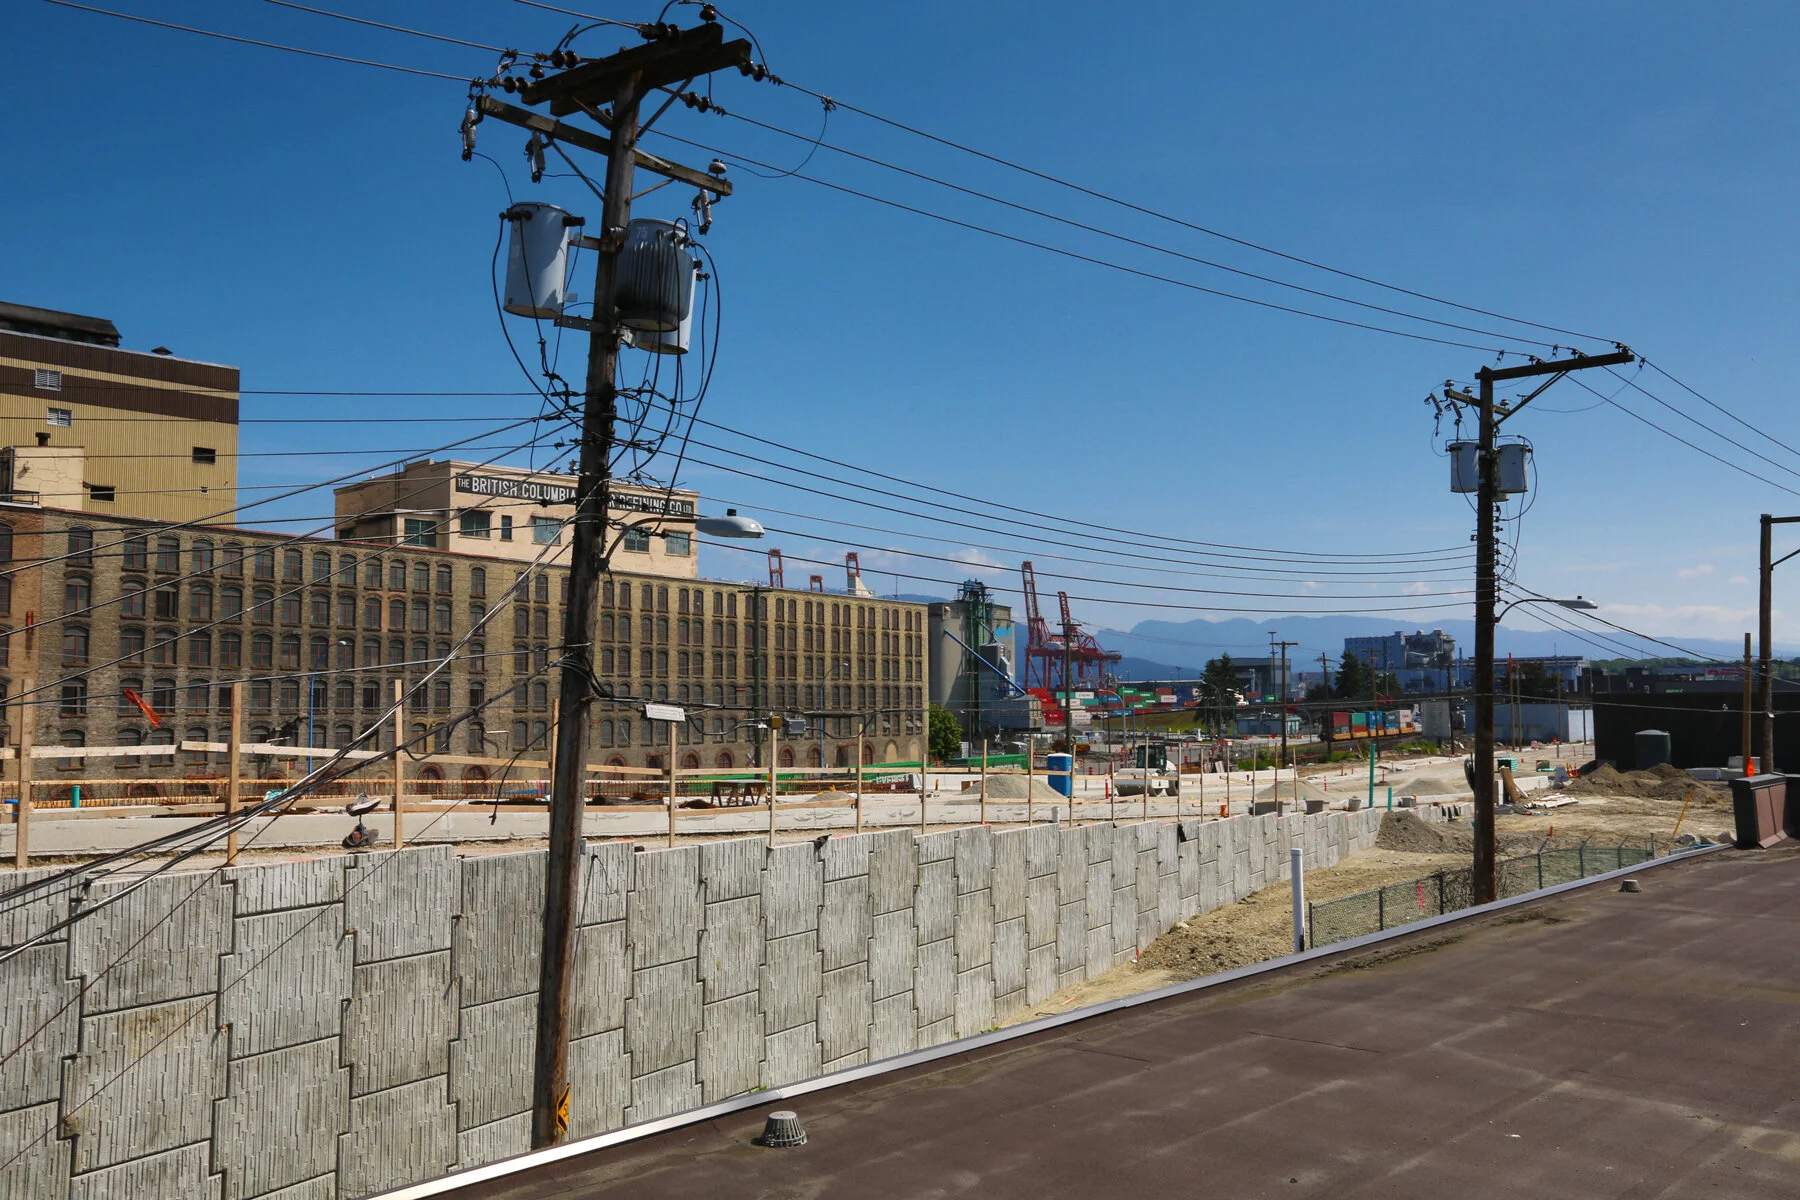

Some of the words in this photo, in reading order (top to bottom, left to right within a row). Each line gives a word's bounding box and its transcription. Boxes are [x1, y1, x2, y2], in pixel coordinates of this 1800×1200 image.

[458, 478, 470, 488] THE
[471, 477, 518, 497] BRITISH
[521, 484, 576, 501] COLUMBIA
